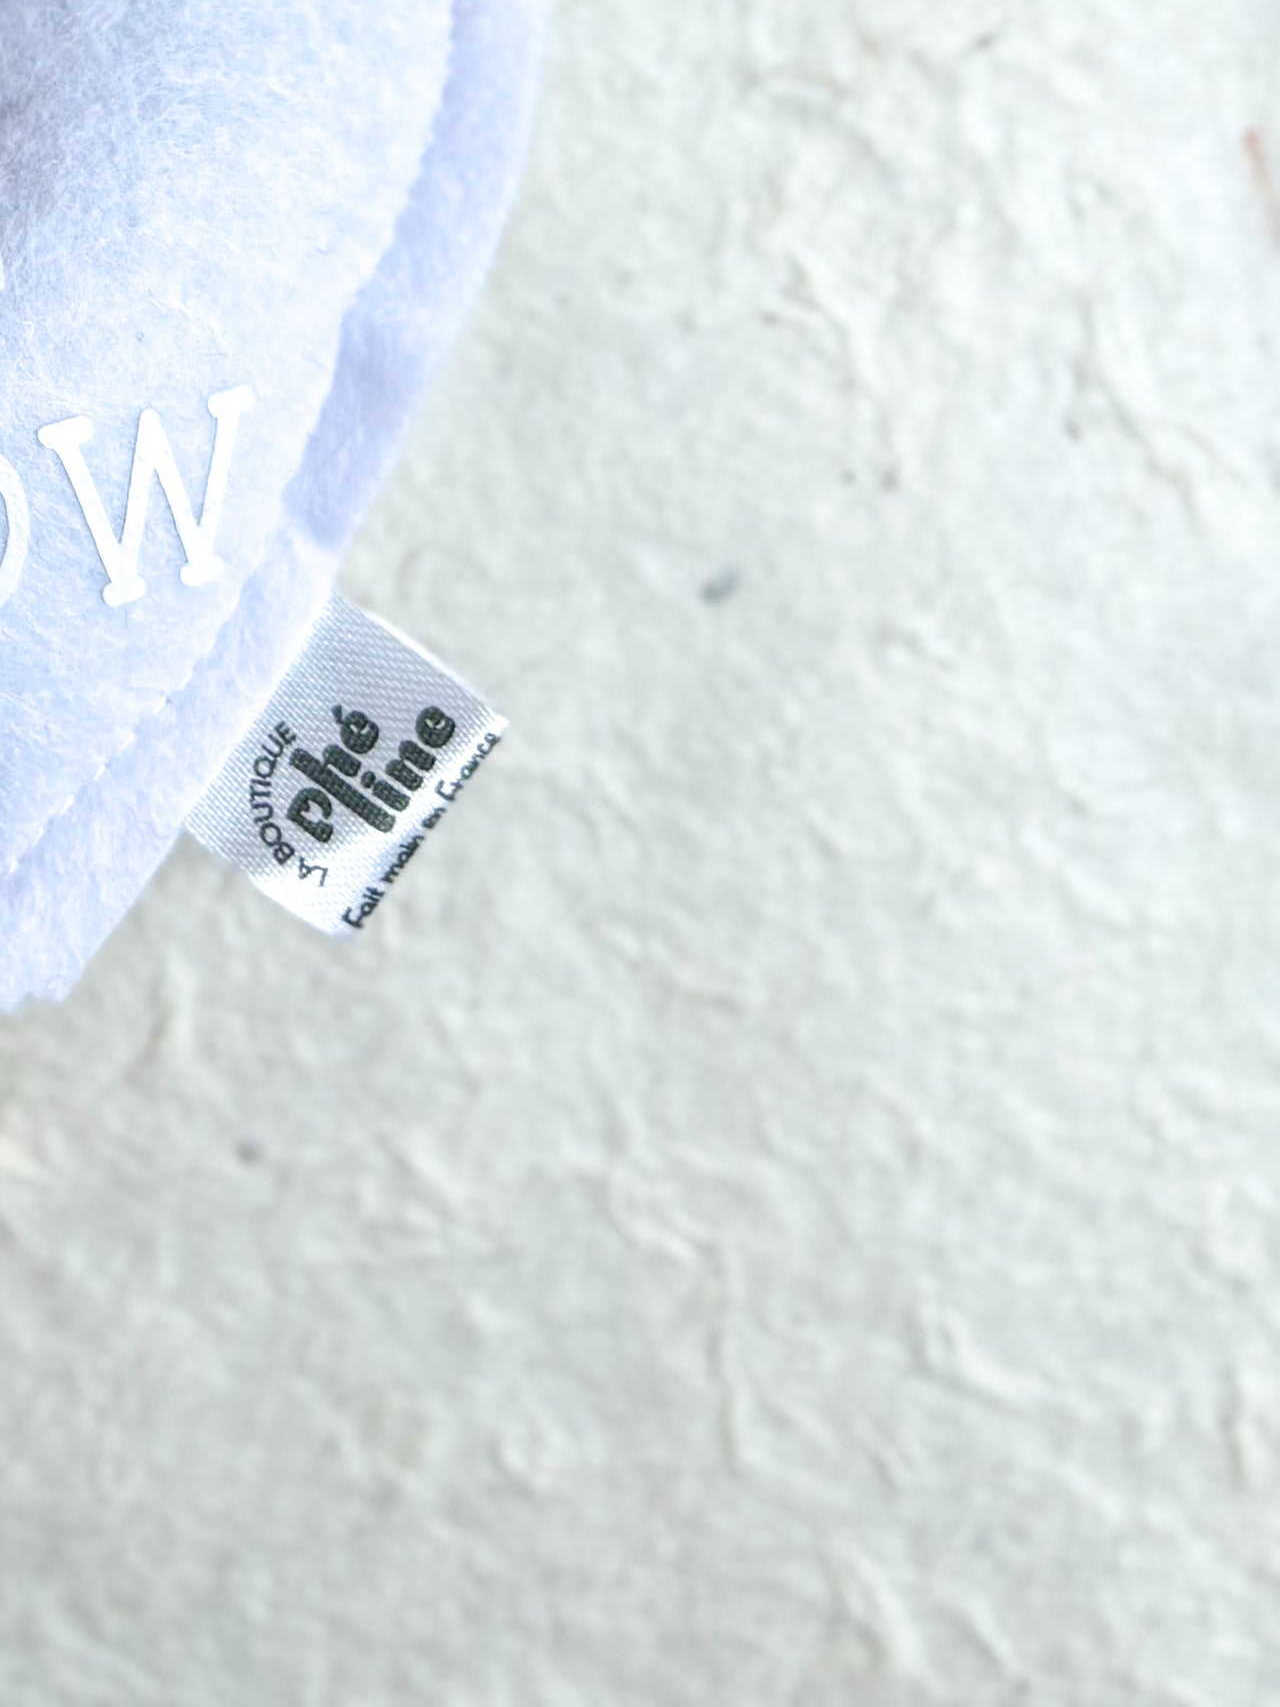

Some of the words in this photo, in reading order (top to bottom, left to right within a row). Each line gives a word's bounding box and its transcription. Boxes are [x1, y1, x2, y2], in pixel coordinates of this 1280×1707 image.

[249, 721, 297, 865] BOUTIQUE
[342, 887, 385, 929] Fait
[381, 835, 425, 884] main
[422, 807, 447, 830] en
[435, 733, 501, 801] France
[298, 856, 328, 887] LA
